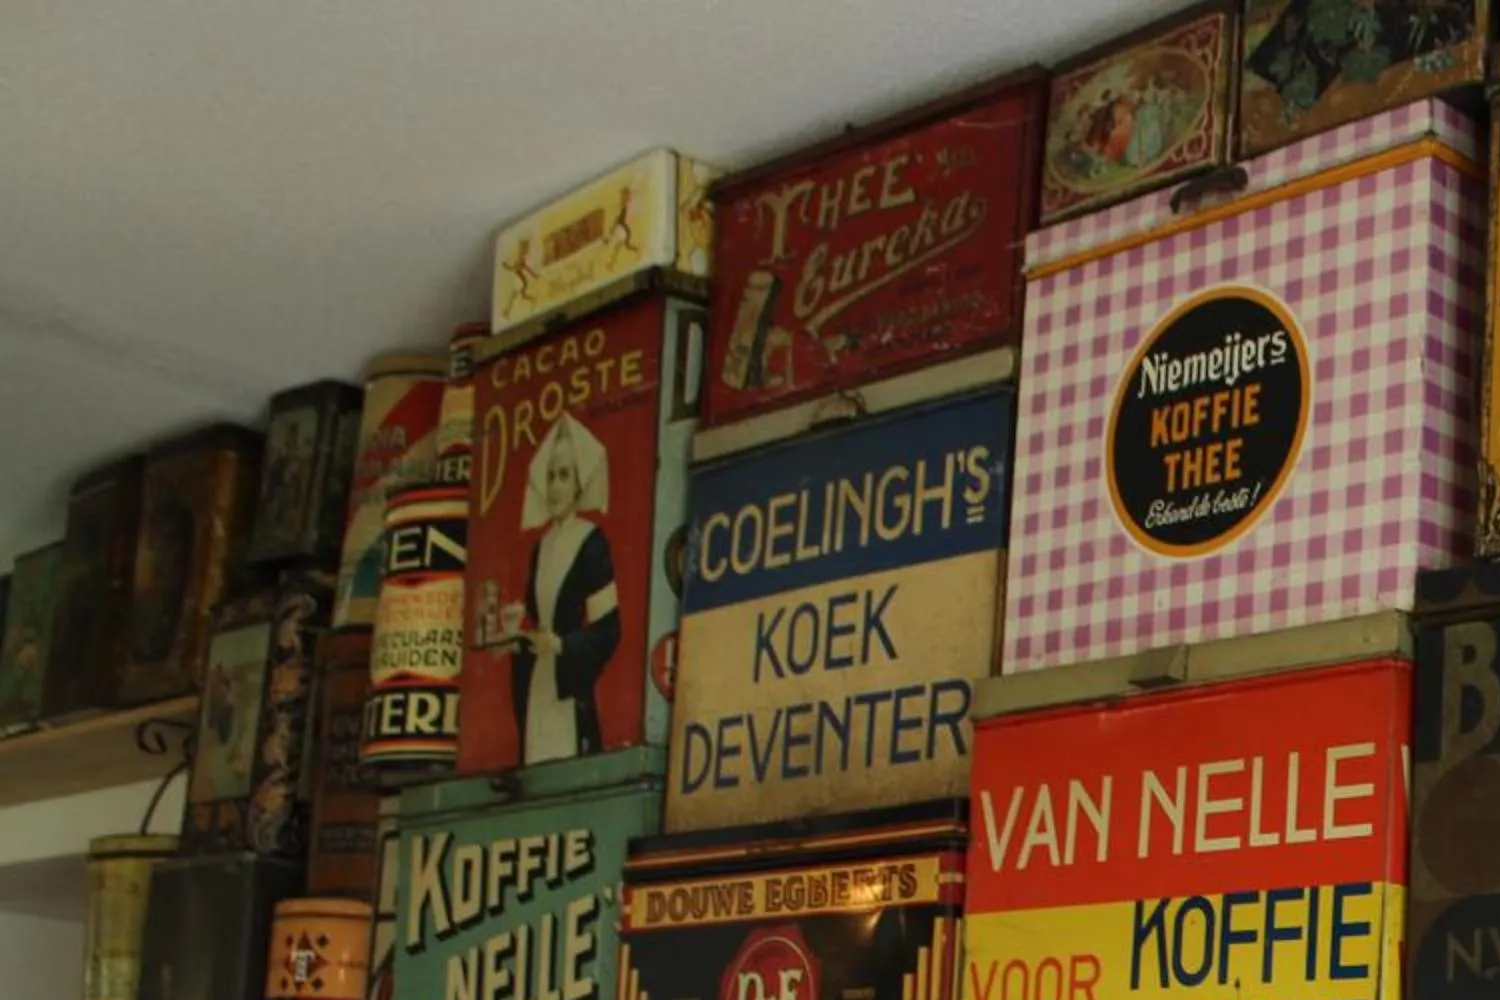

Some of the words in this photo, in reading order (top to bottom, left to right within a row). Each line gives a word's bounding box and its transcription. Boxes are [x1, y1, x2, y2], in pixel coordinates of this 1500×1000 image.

[756, 155, 916, 264] THEE
[492, 329, 605, 389] CACAO
[1137, 329, 1287, 400] Niemeijers
[480, 351, 644, 517] DROSTE
[1151, 384, 1261, 448] KOFFIE
[1164, 439, 1243, 492] THEE
[700, 445, 991, 583] COELINGH'S
[752, 583, 899, 684] KOEK
[682, 678, 973, 796] DEVENTER
[981, 775, 1112, 872] VAN
[1138, 742, 1375, 859] NELLE
[406, 828, 594, 953] KOFFIE
[646, 880, 755, 924] DOUWE
[764, 863, 918, 913] EGBERTS
[1131, 882, 1373, 990] KOFFIE
